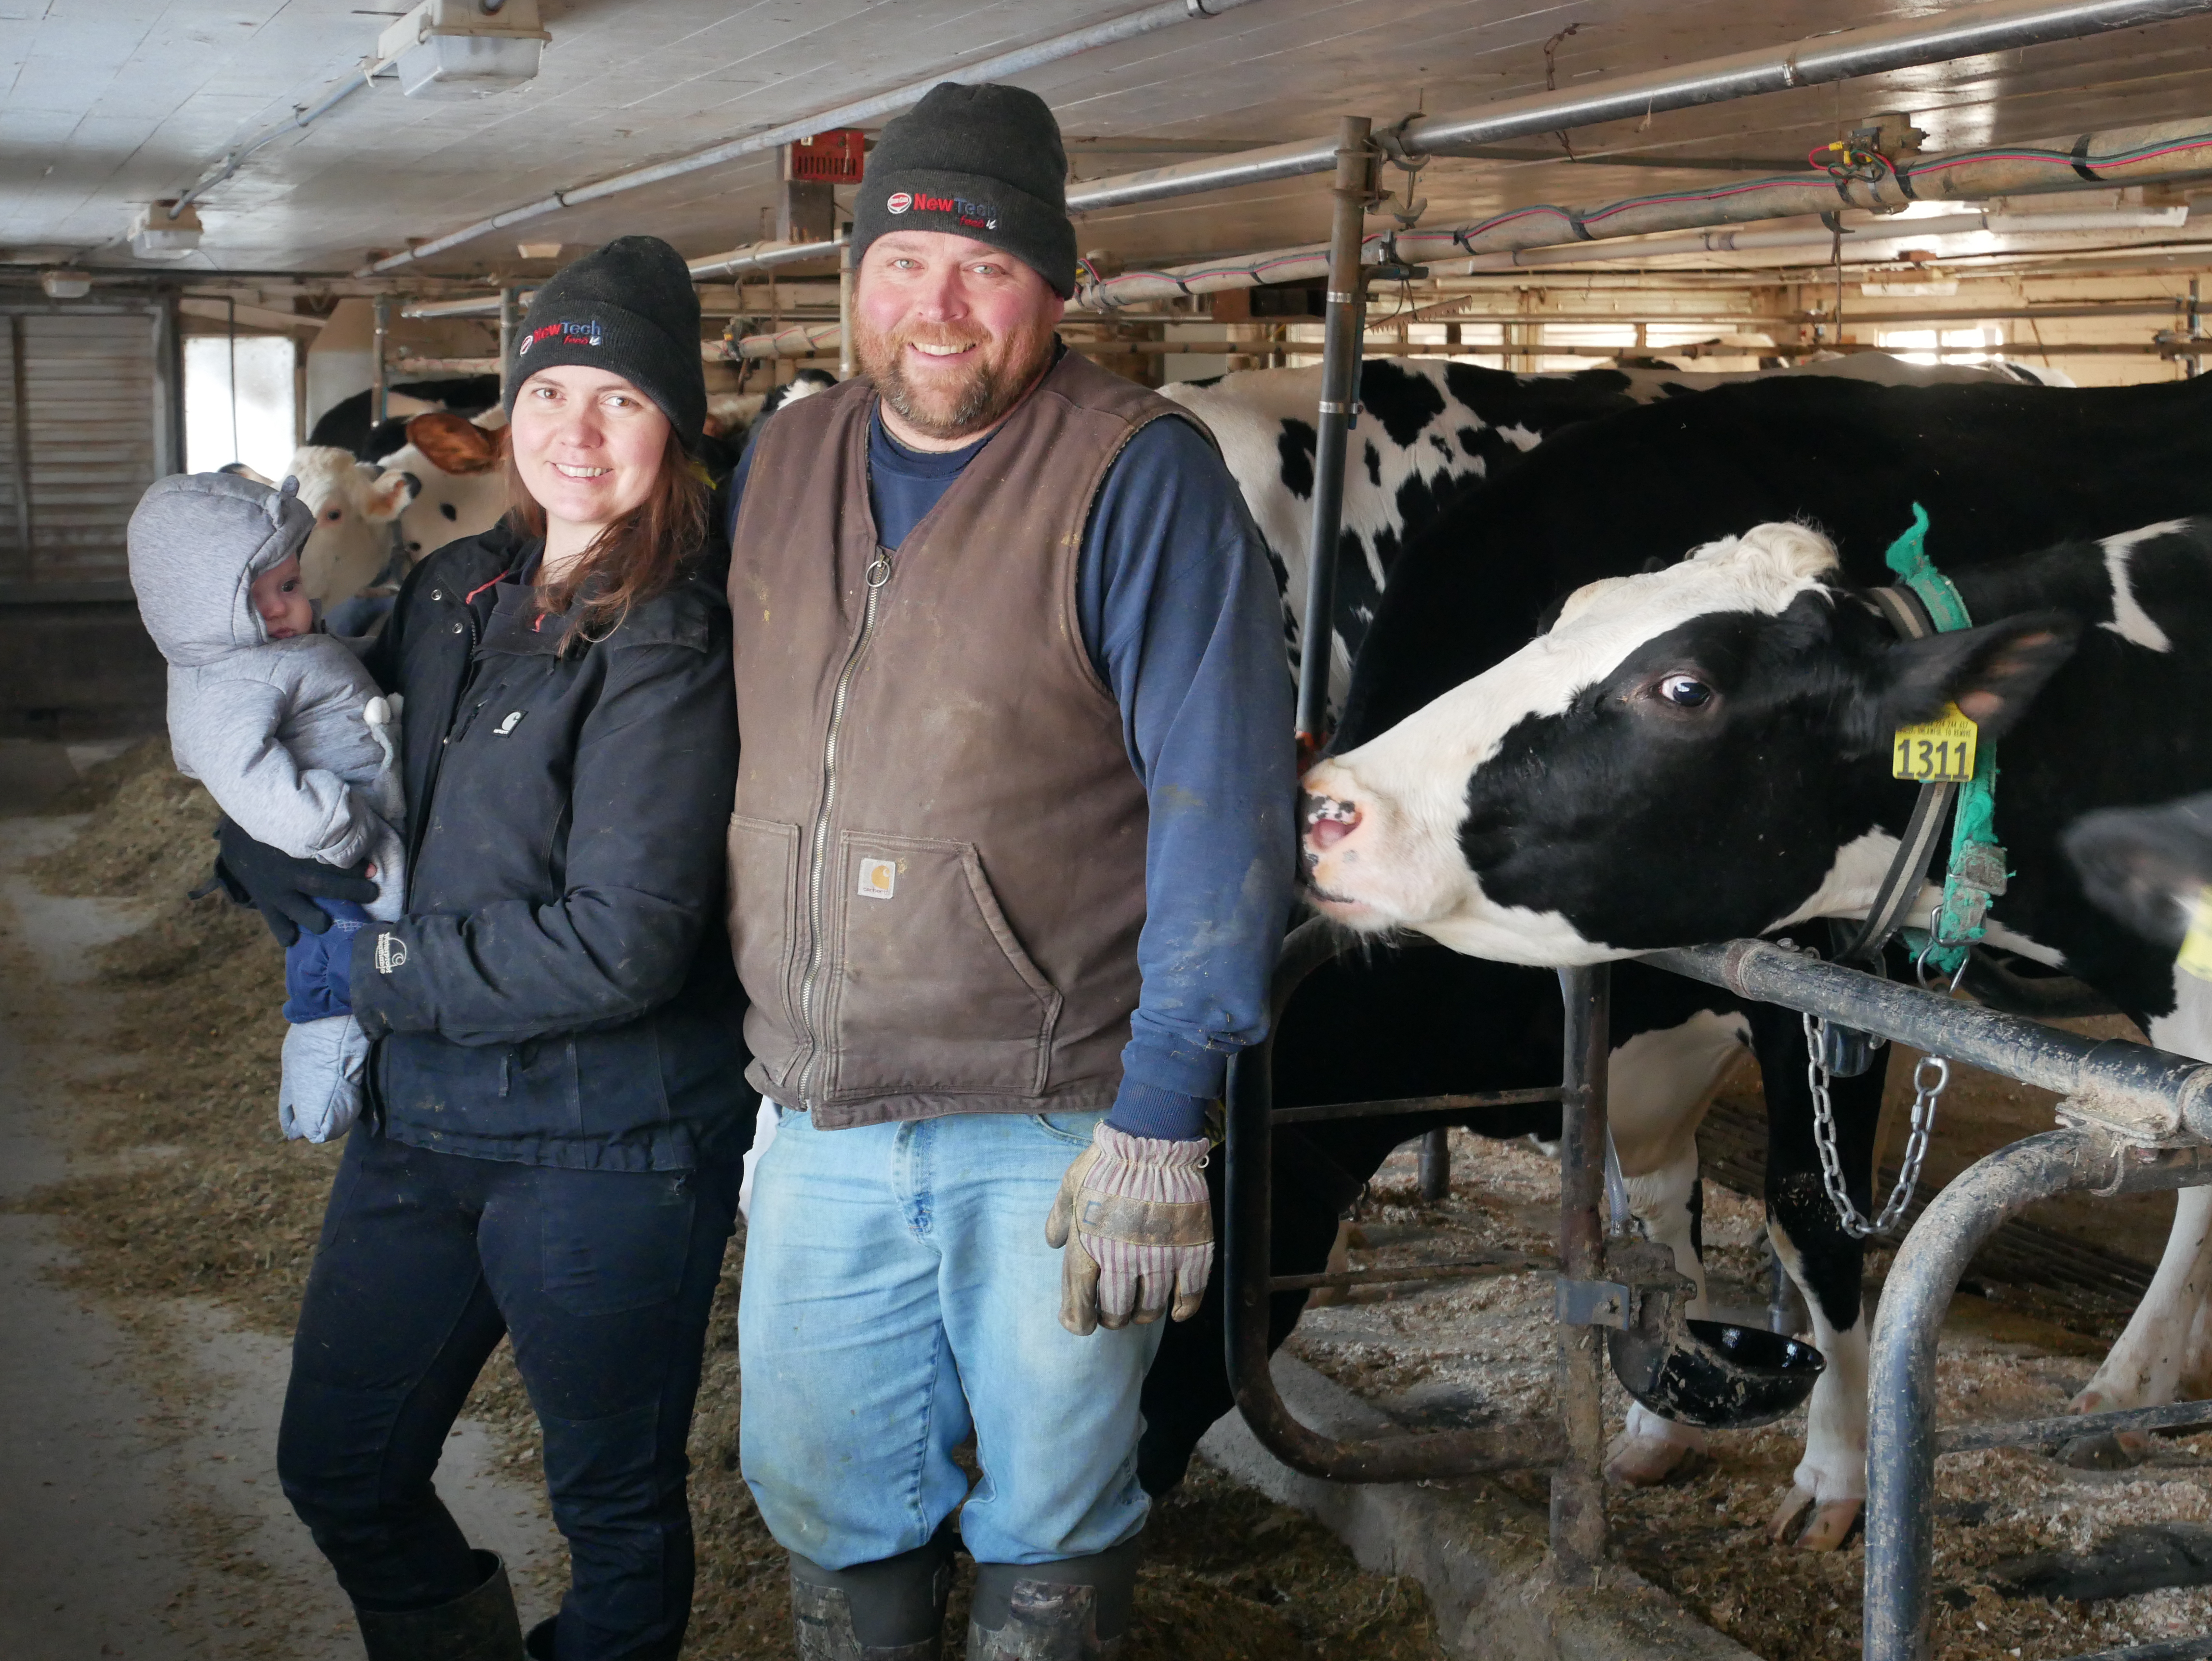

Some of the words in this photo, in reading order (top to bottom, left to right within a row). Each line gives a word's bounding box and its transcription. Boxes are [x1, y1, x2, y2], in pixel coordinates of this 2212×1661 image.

[913, 193, 997, 217] NewTech
[533, 320, 601, 344] NewTech
[1897, 738, 1970, 779] 1311
[384, 932, 393, 973] Waterproof
